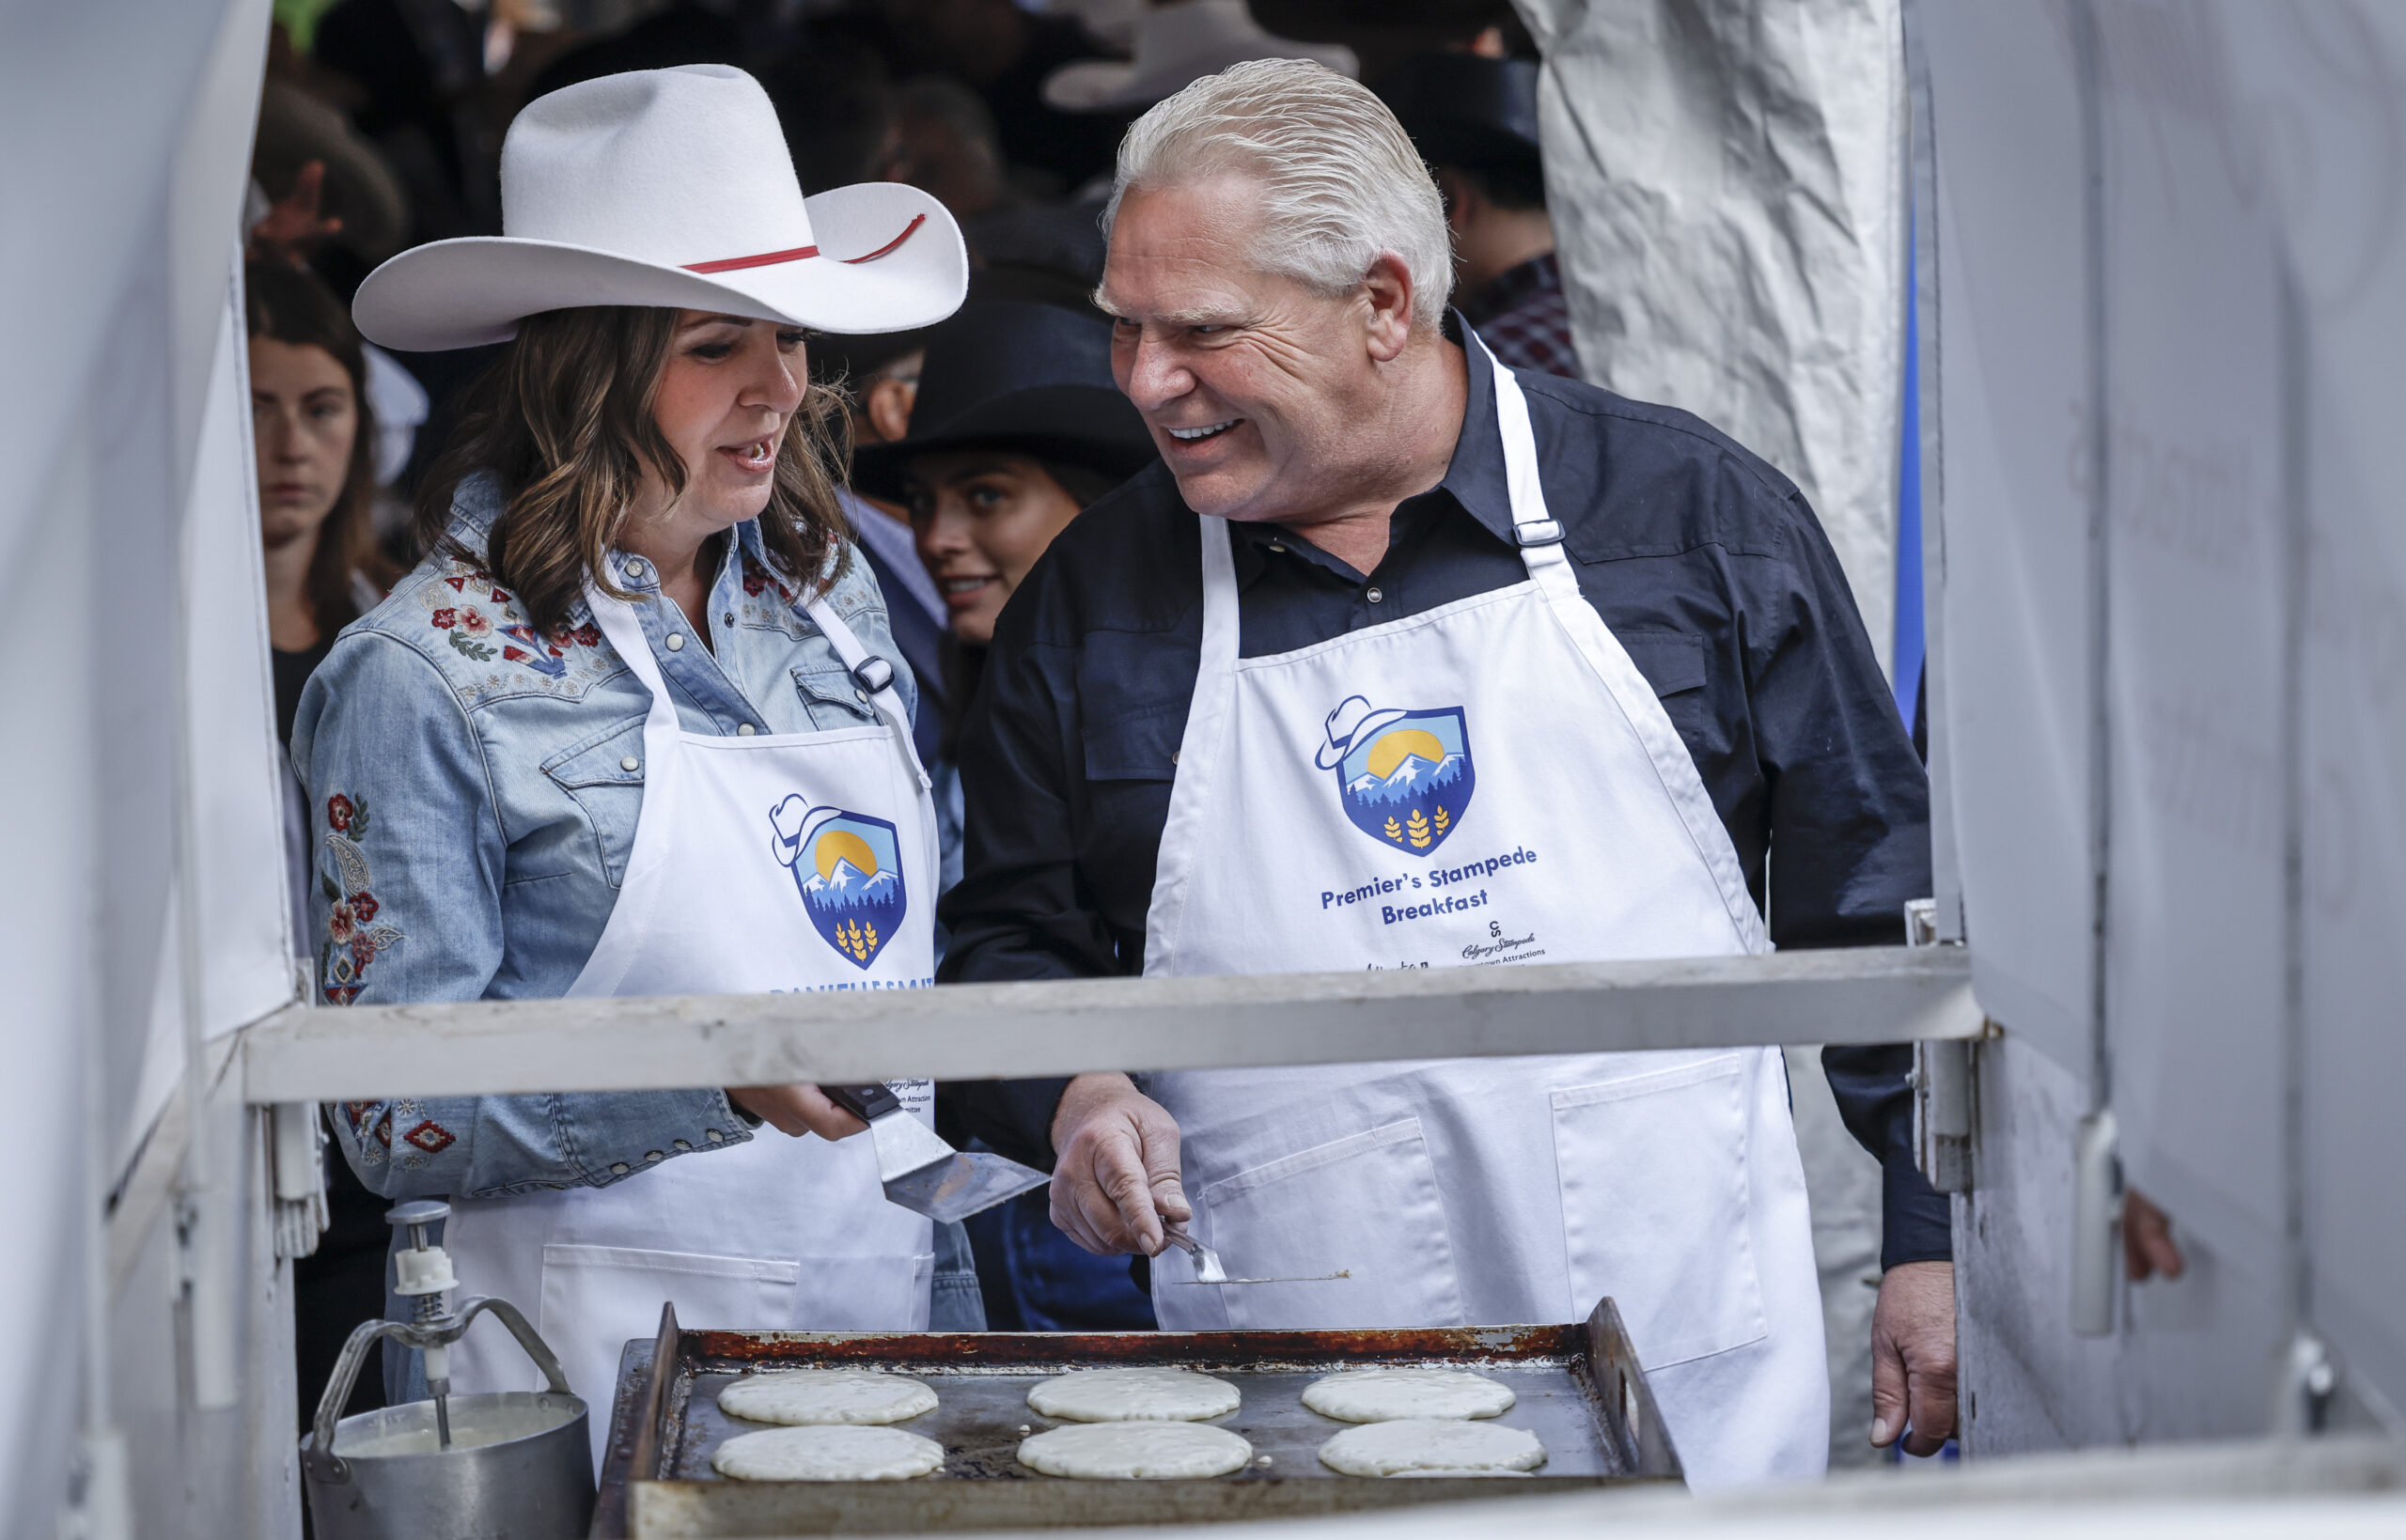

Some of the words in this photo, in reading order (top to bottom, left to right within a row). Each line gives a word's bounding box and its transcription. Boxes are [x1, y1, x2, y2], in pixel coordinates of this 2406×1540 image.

[1320, 873, 1422, 910] Premier's
[1428, 846, 1538, 888] Stampede
[1381, 889, 1489, 925] Breakfast
[1461, 943, 1494, 960] Calgary
[1494, 932, 1537, 953] Stampede
[1502, 948, 1546, 964] Attractions
